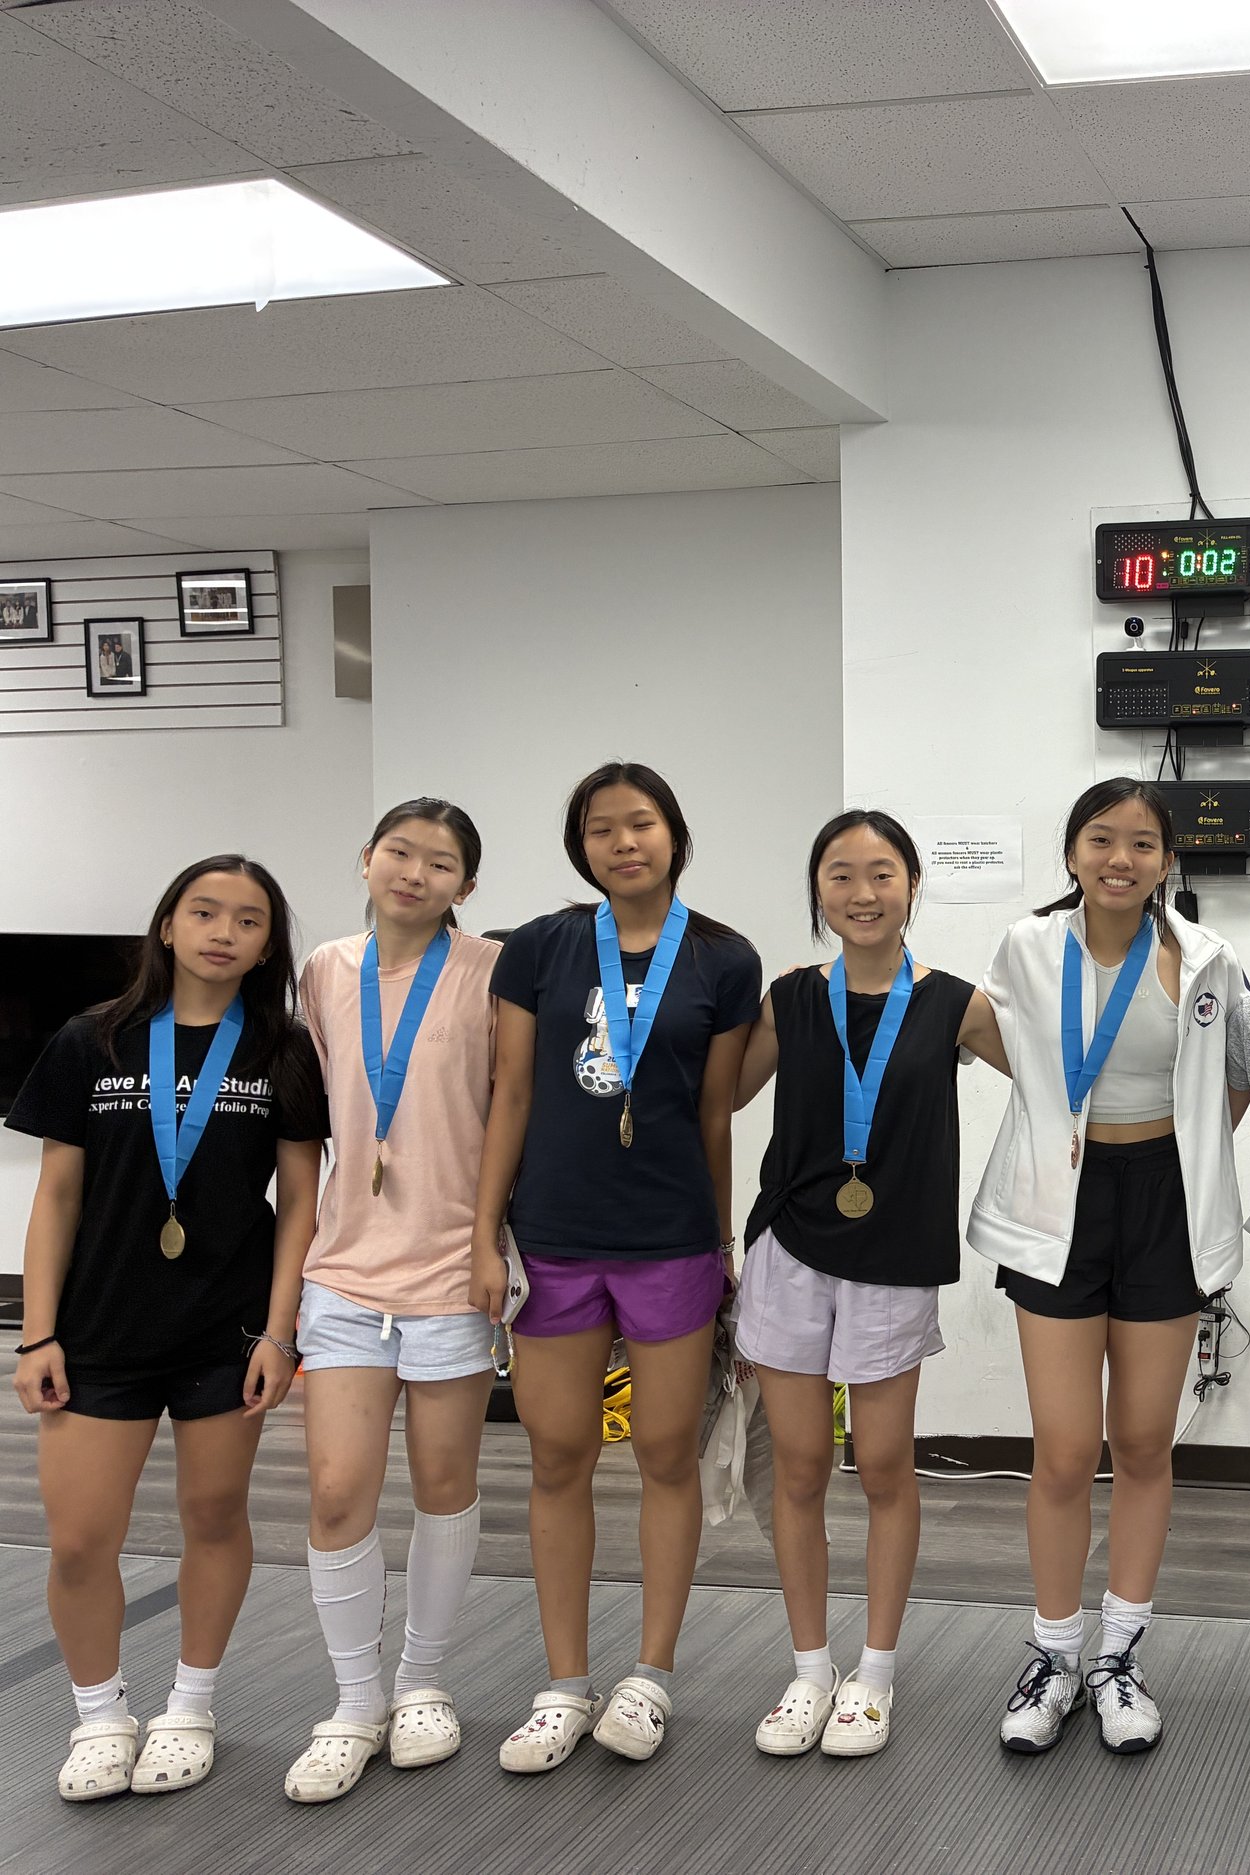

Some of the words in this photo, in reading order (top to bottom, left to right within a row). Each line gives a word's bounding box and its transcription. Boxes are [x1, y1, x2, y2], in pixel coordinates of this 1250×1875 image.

[1123, 554, 1153, 589] 10
[1179, 549, 1236, 576] 0:02
[88, 1100, 118, 1114] xpert
[121, 1098, 133, 1110] in
[249, 1103, 270, 1118] Prep
